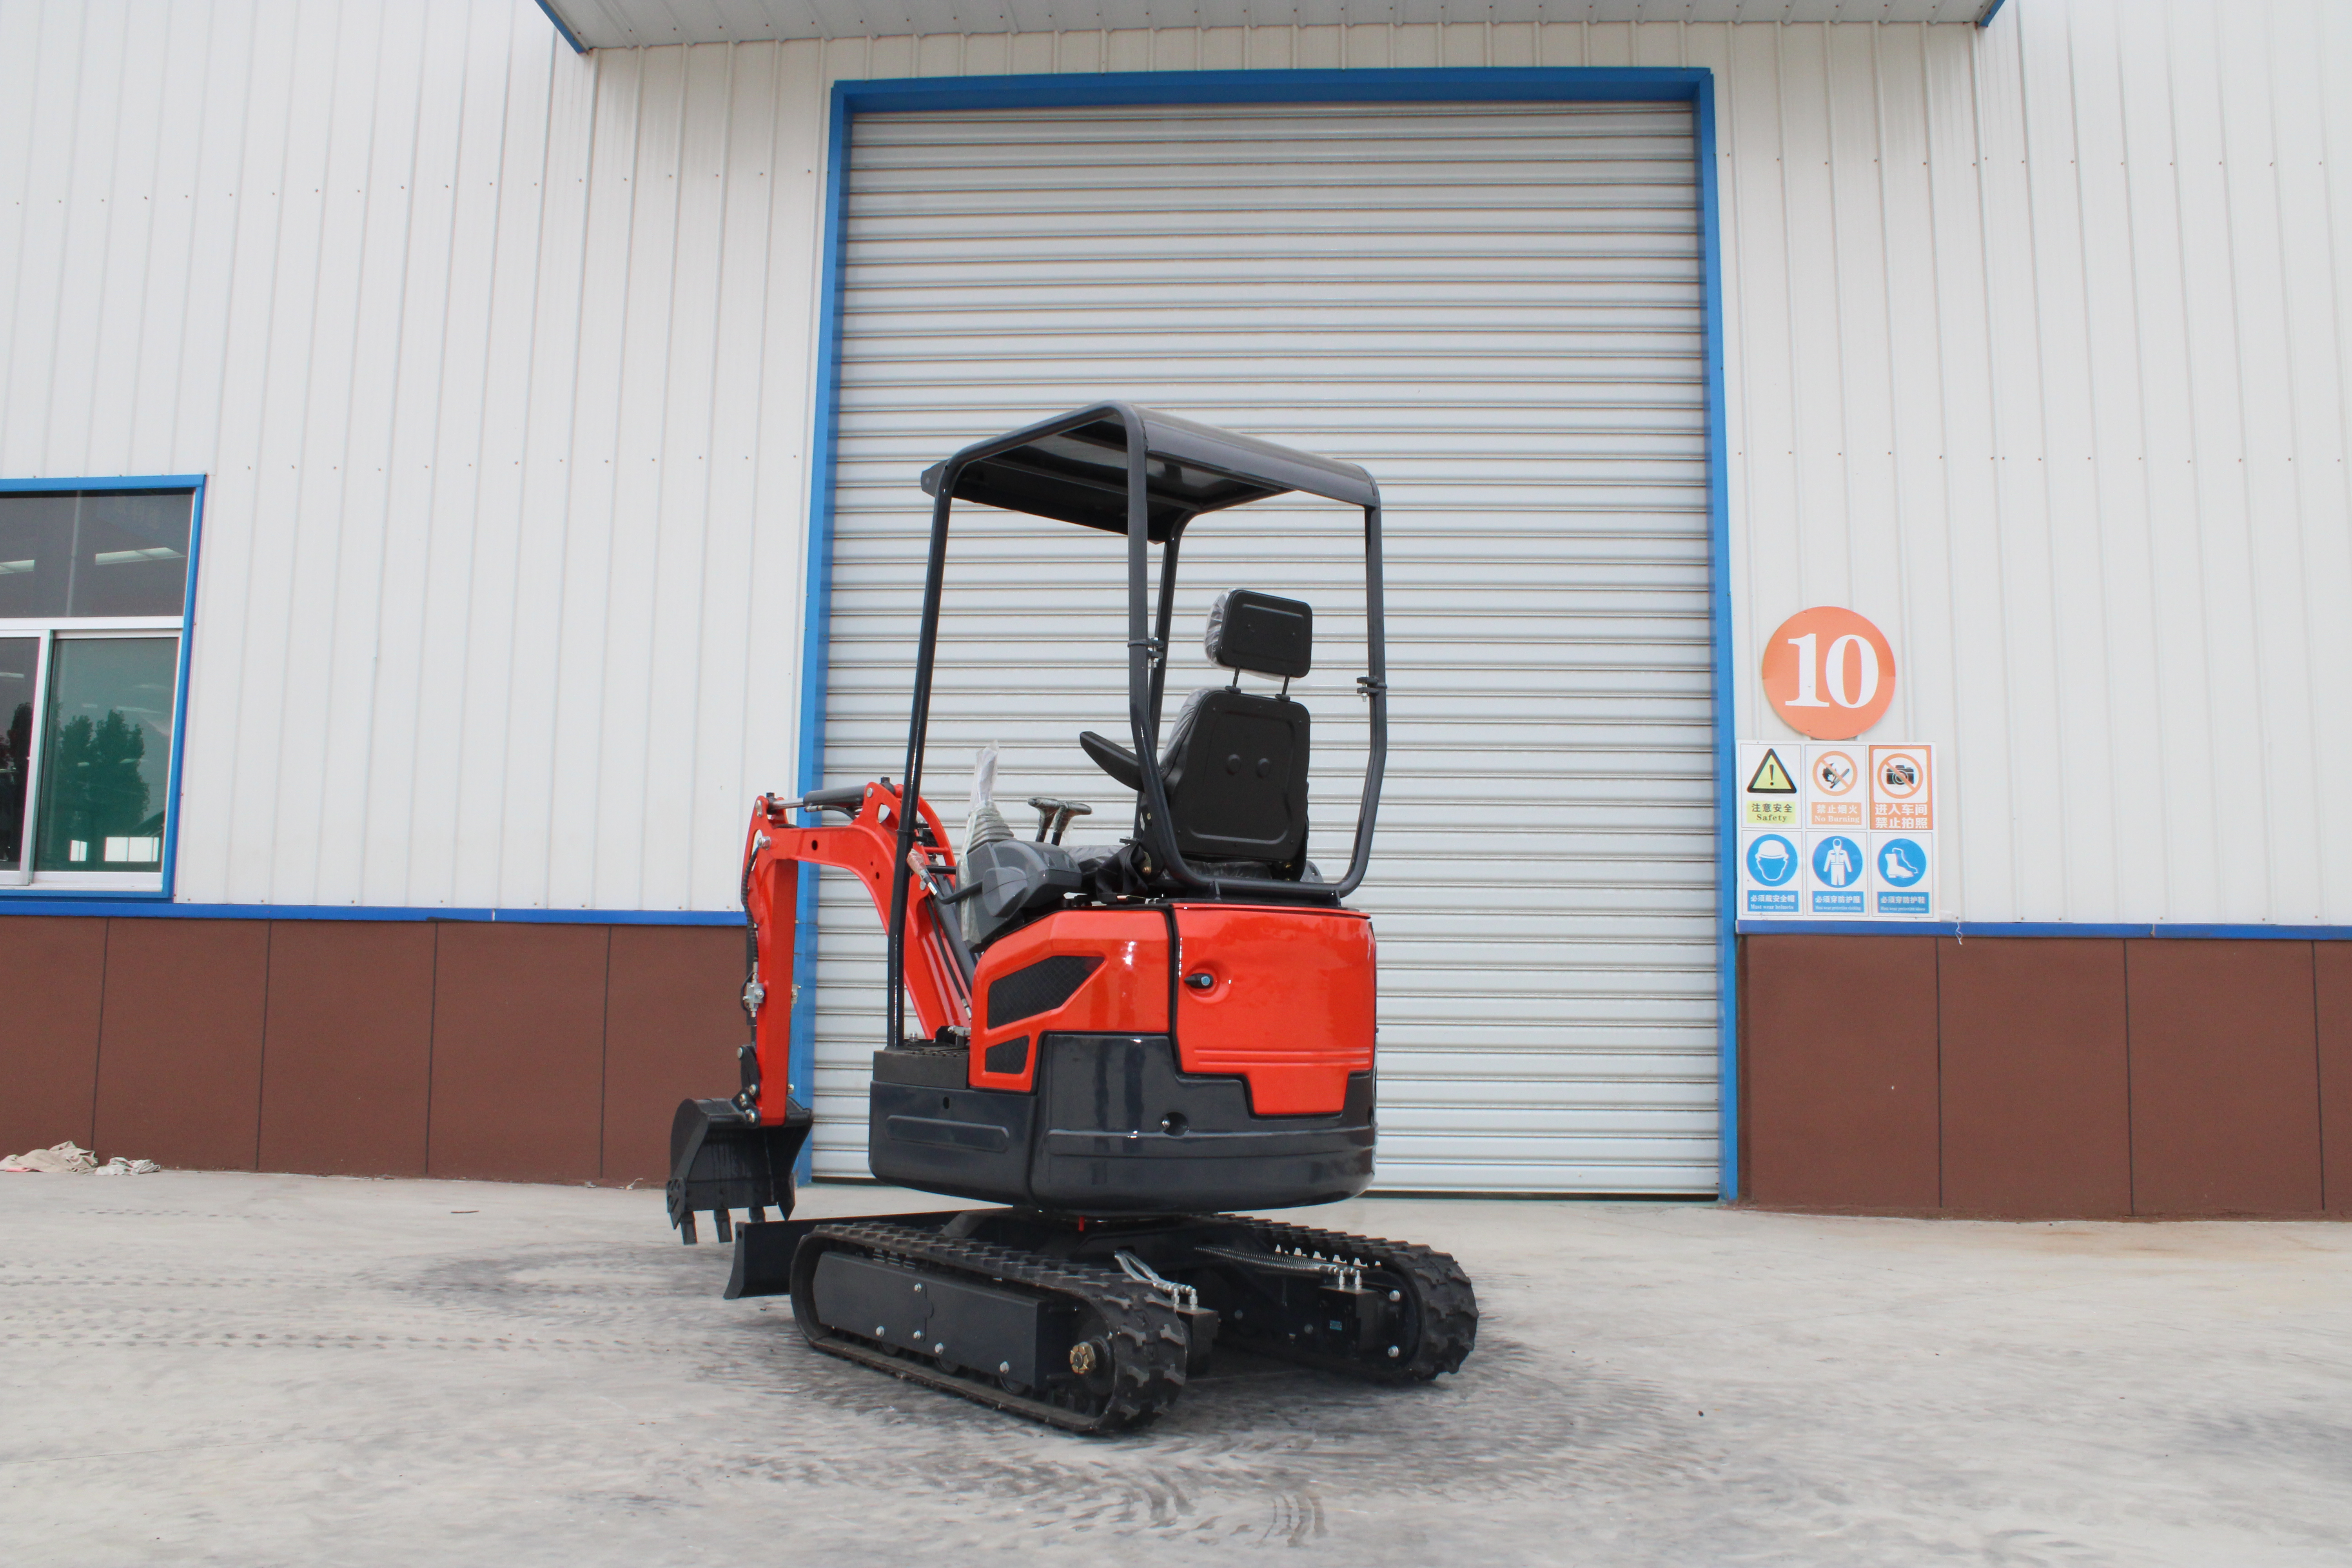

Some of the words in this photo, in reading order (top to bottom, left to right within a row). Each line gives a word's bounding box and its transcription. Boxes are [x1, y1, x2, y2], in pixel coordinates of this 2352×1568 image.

[1785, 633, 1879, 709] 10
[1751, 803, 1793, 813] 注意安全
[1817, 804, 1857, 814] 禁止烟火
[1875, 804, 1927, 815] 进入车间
[1756, 814, 1787, 822] Safety
[1875, 817, 1928, 829] 禁止拍照
